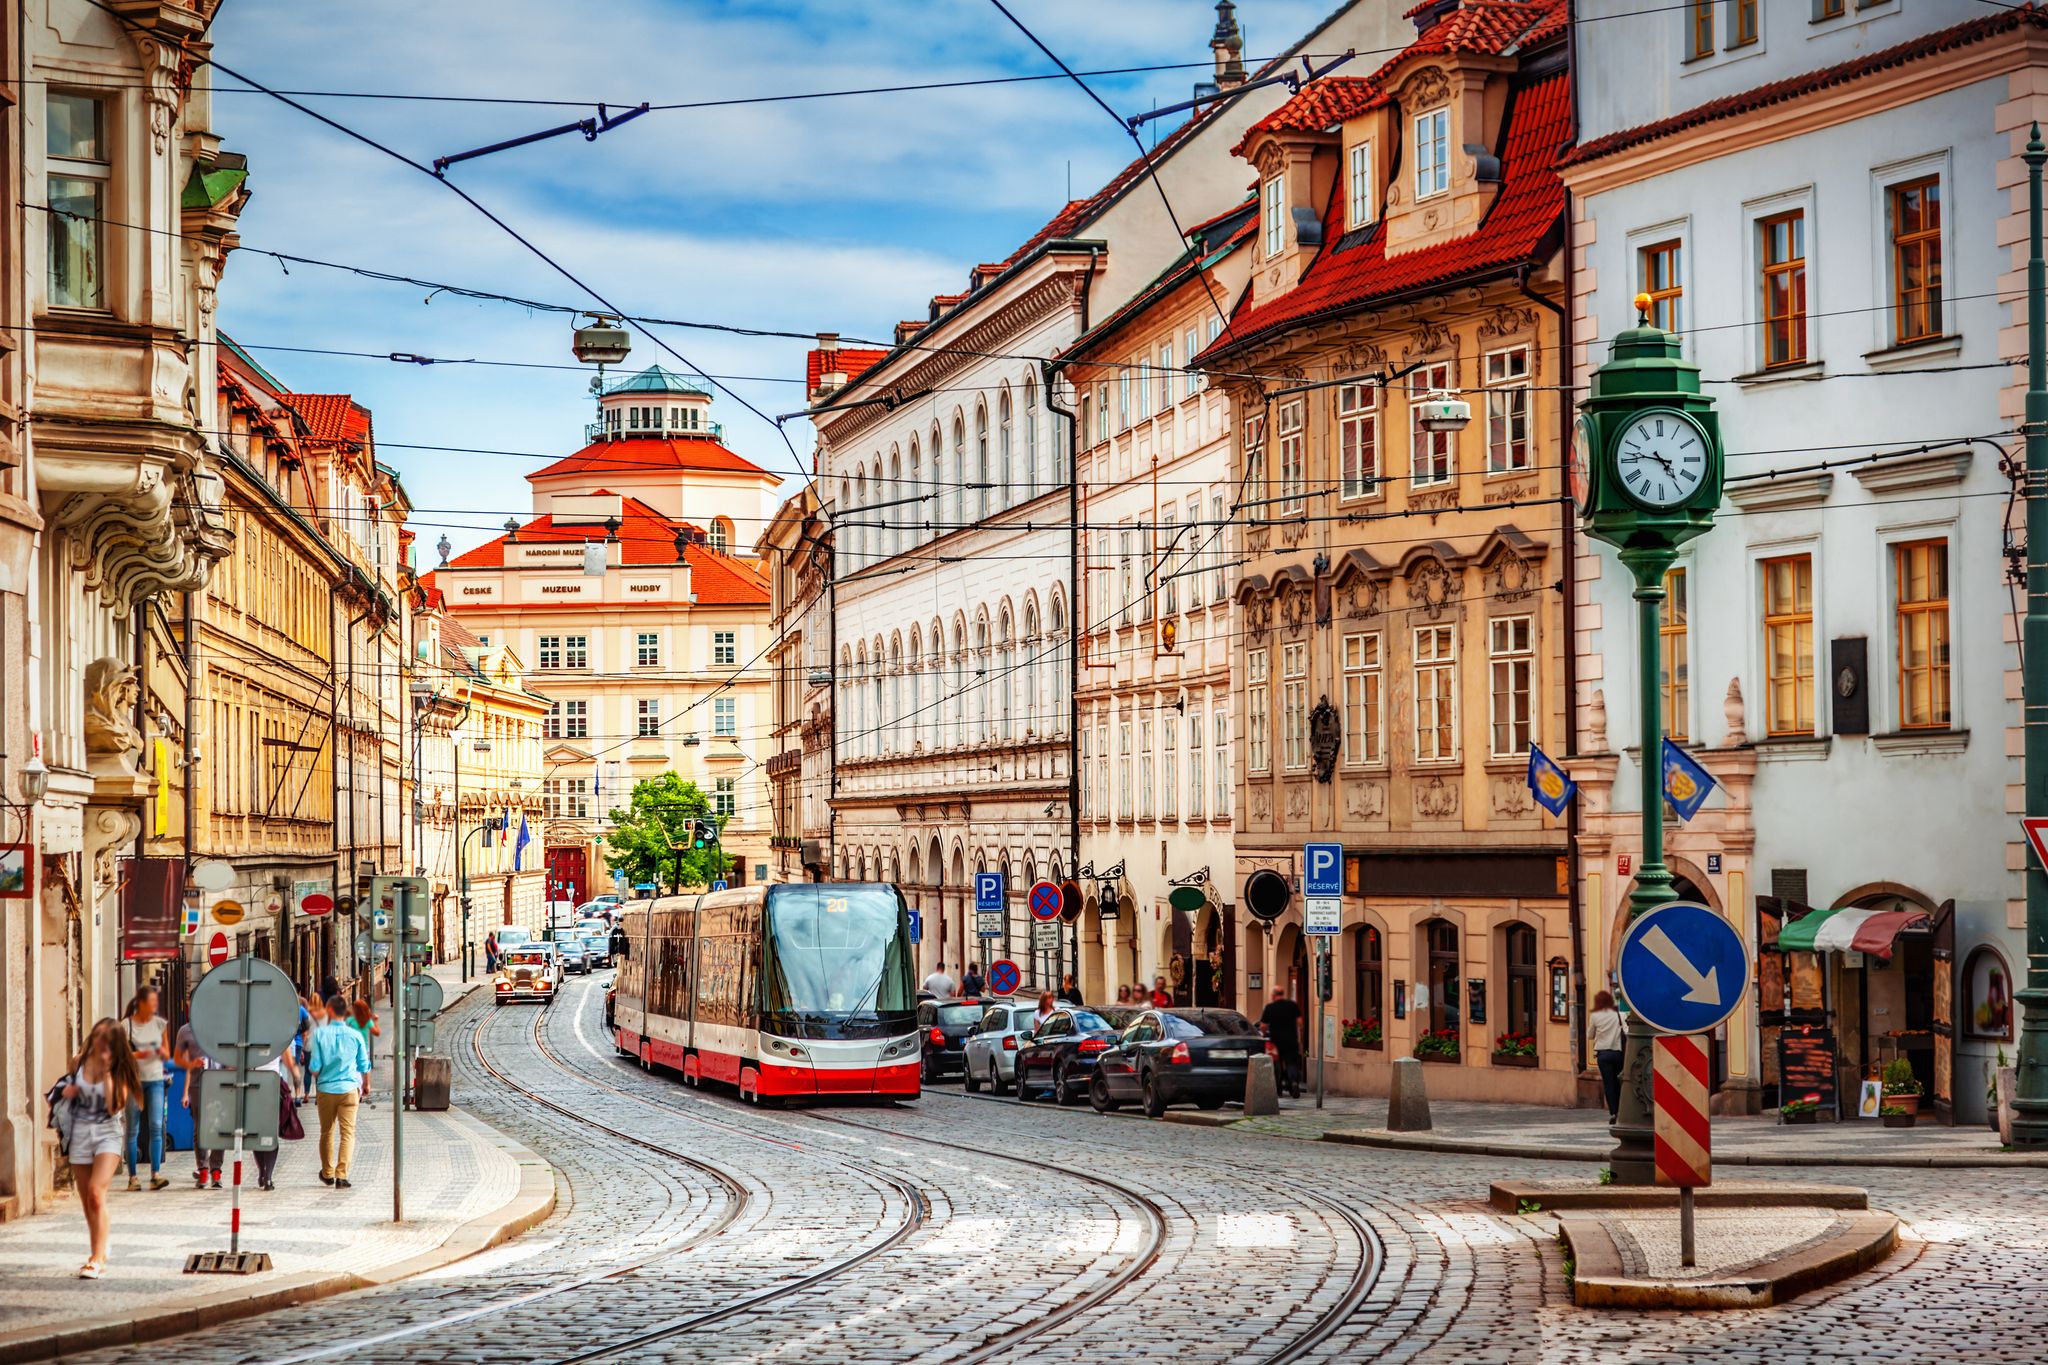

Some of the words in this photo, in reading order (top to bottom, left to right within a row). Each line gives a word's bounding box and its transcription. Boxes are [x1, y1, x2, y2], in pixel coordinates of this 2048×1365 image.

[525, 548, 560, 556] NÁRODNÍ
[463, 586, 492, 595] ČESKÉ
[630, 584, 661, 592] HUDBY
[1313, 850, 1334, 879] P
[982, 878, 996, 899] P
[1308, 882, 1339, 890] RÉSERVÉ
[827, 897, 848, 913] 20
